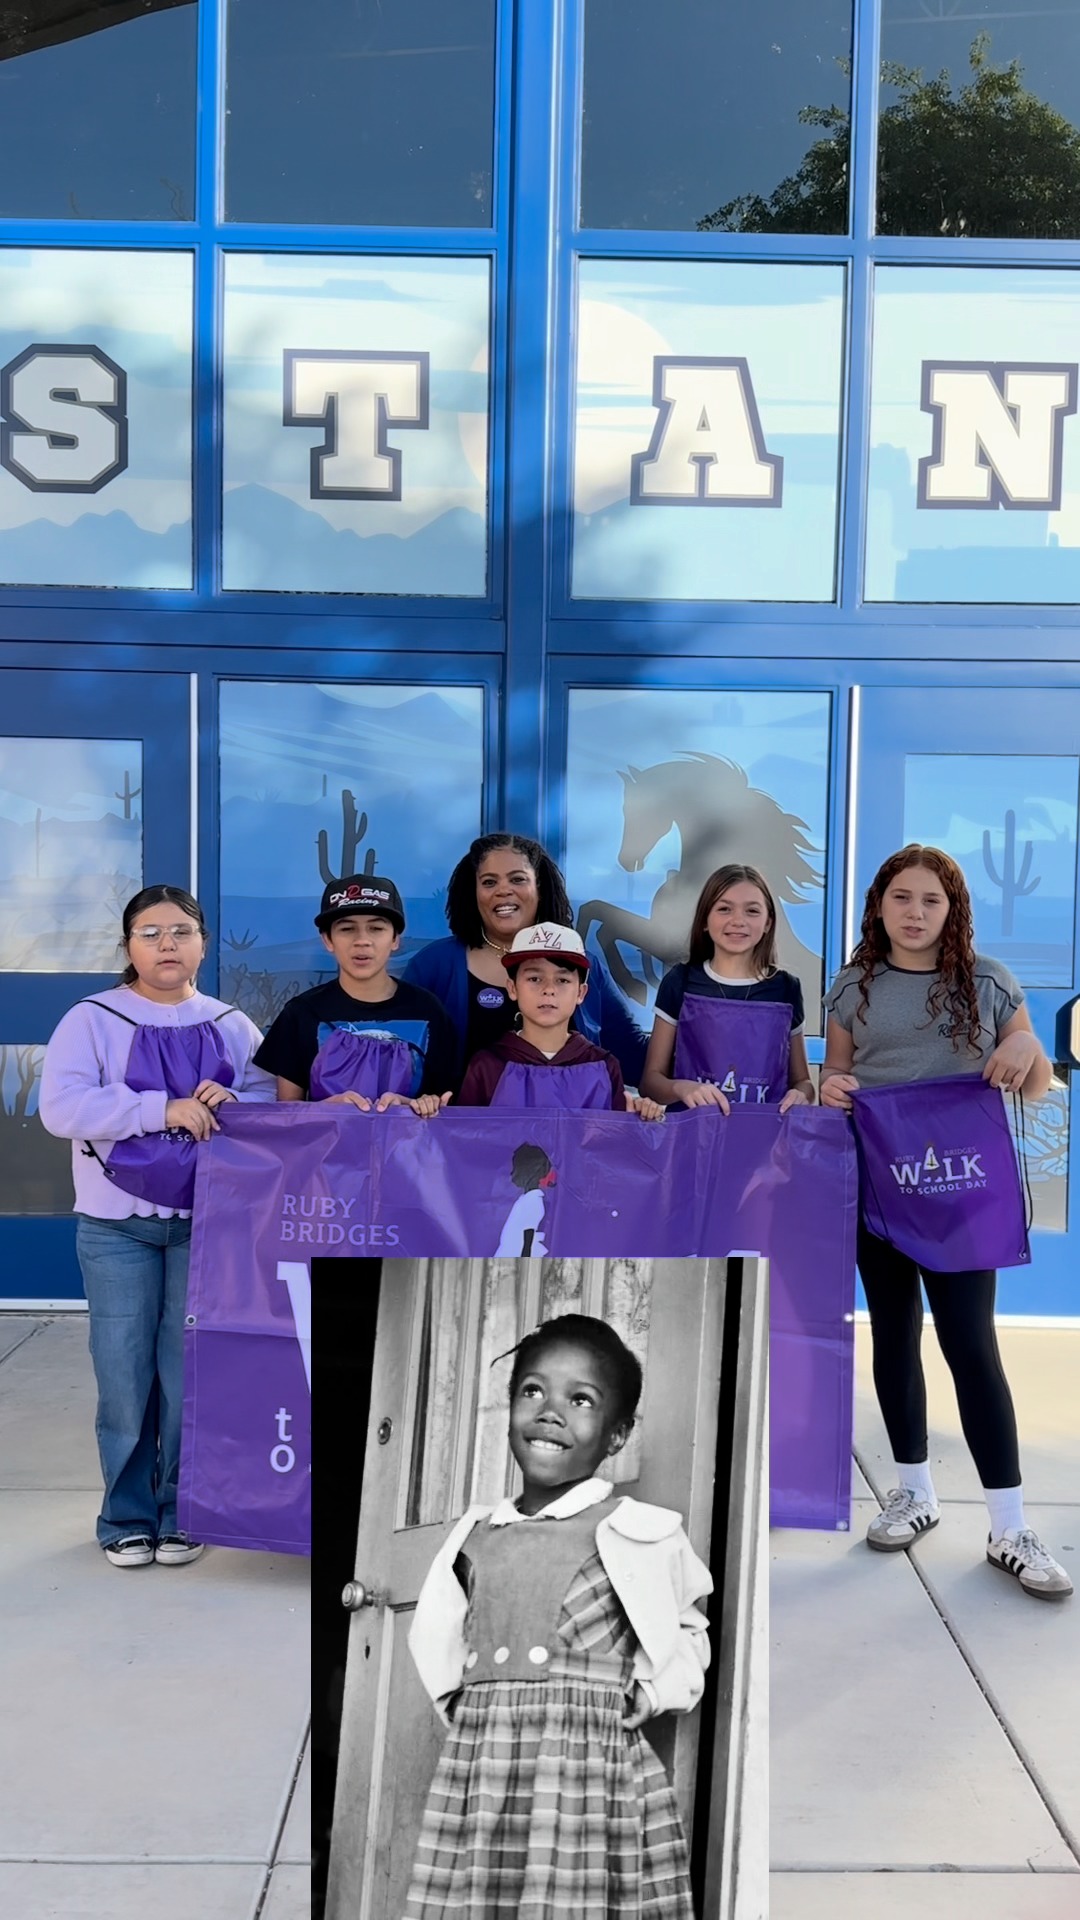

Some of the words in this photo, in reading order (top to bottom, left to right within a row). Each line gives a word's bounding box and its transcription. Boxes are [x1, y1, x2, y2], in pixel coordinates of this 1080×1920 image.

[338, 897, 380, 908] Racing
[529, 926, 562, 949] AZ
[889, 1146, 986, 1186] WALK
[895, 1155, 915, 1163] RUBY
[944, 1146, 977, 1157] BRIDGES
[900, 1186, 913, 1194] TO
[918, 1182, 962, 1195] SCHOOL
[966, 1179, 988, 1189] DAY
[282, 1194, 356, 1218] RUBY
[280, 1220, 400, 1246] BRIDGES
